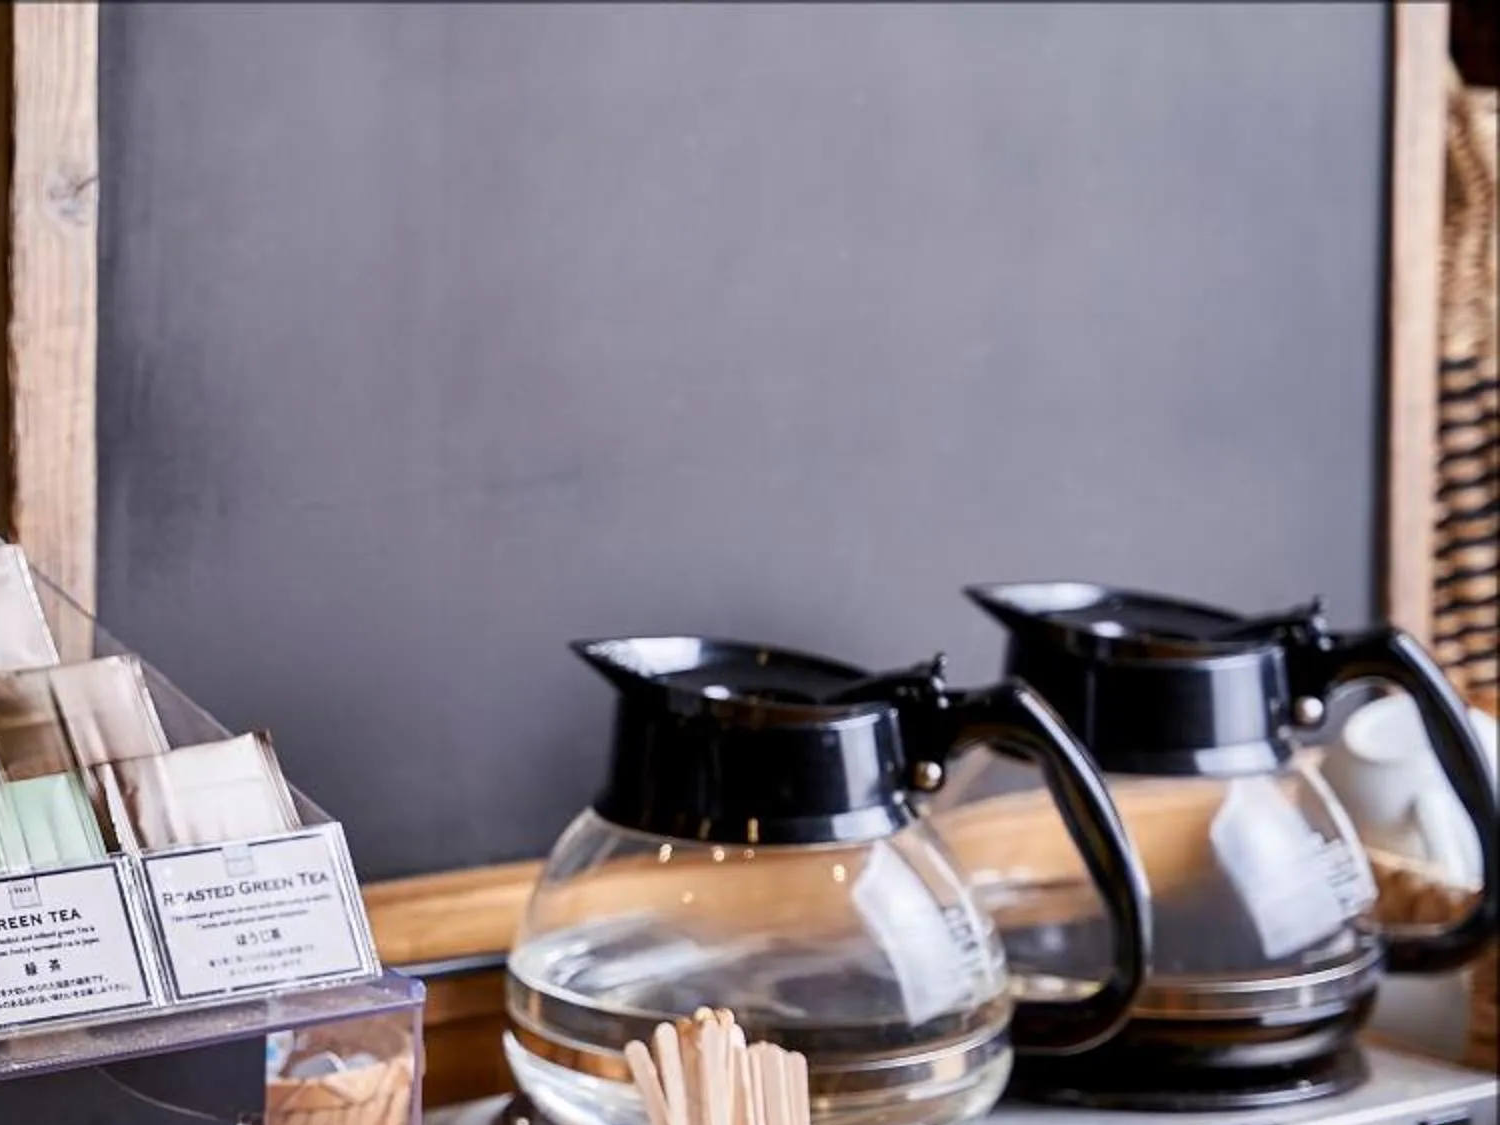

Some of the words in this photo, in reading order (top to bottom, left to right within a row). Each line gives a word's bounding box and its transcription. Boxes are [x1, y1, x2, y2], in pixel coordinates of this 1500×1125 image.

[238, 878, 294, 895] GREEN
[297, 872, 329, 885] TEA
[47, 908, 82, 923] TEA
